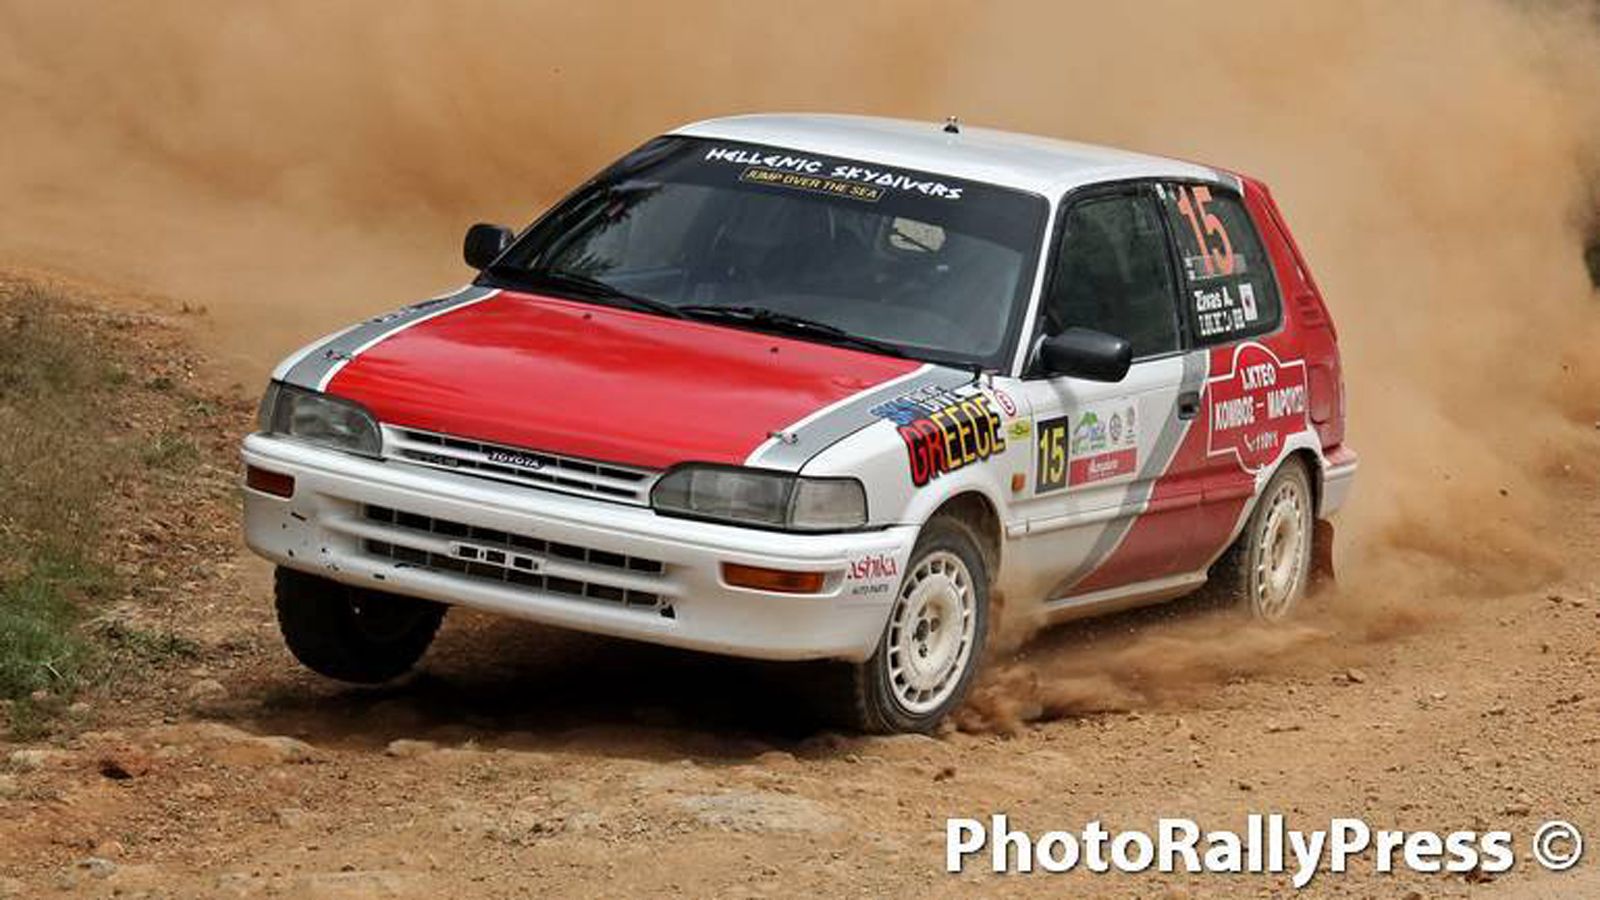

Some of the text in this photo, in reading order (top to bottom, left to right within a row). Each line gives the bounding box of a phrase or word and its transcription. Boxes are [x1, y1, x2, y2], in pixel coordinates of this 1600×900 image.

[706, 148, 963, 199] HELLENIC SKYDIVERS
[747, 170, 878, 198] JUMP OVER THE SEA
[1177, 185, 1233, 279] 15
[490, 451, 541, 469] TOYOTA
[897, 393, 1006, 488] GREECE
[1040, 426, 1065, 485] 15
